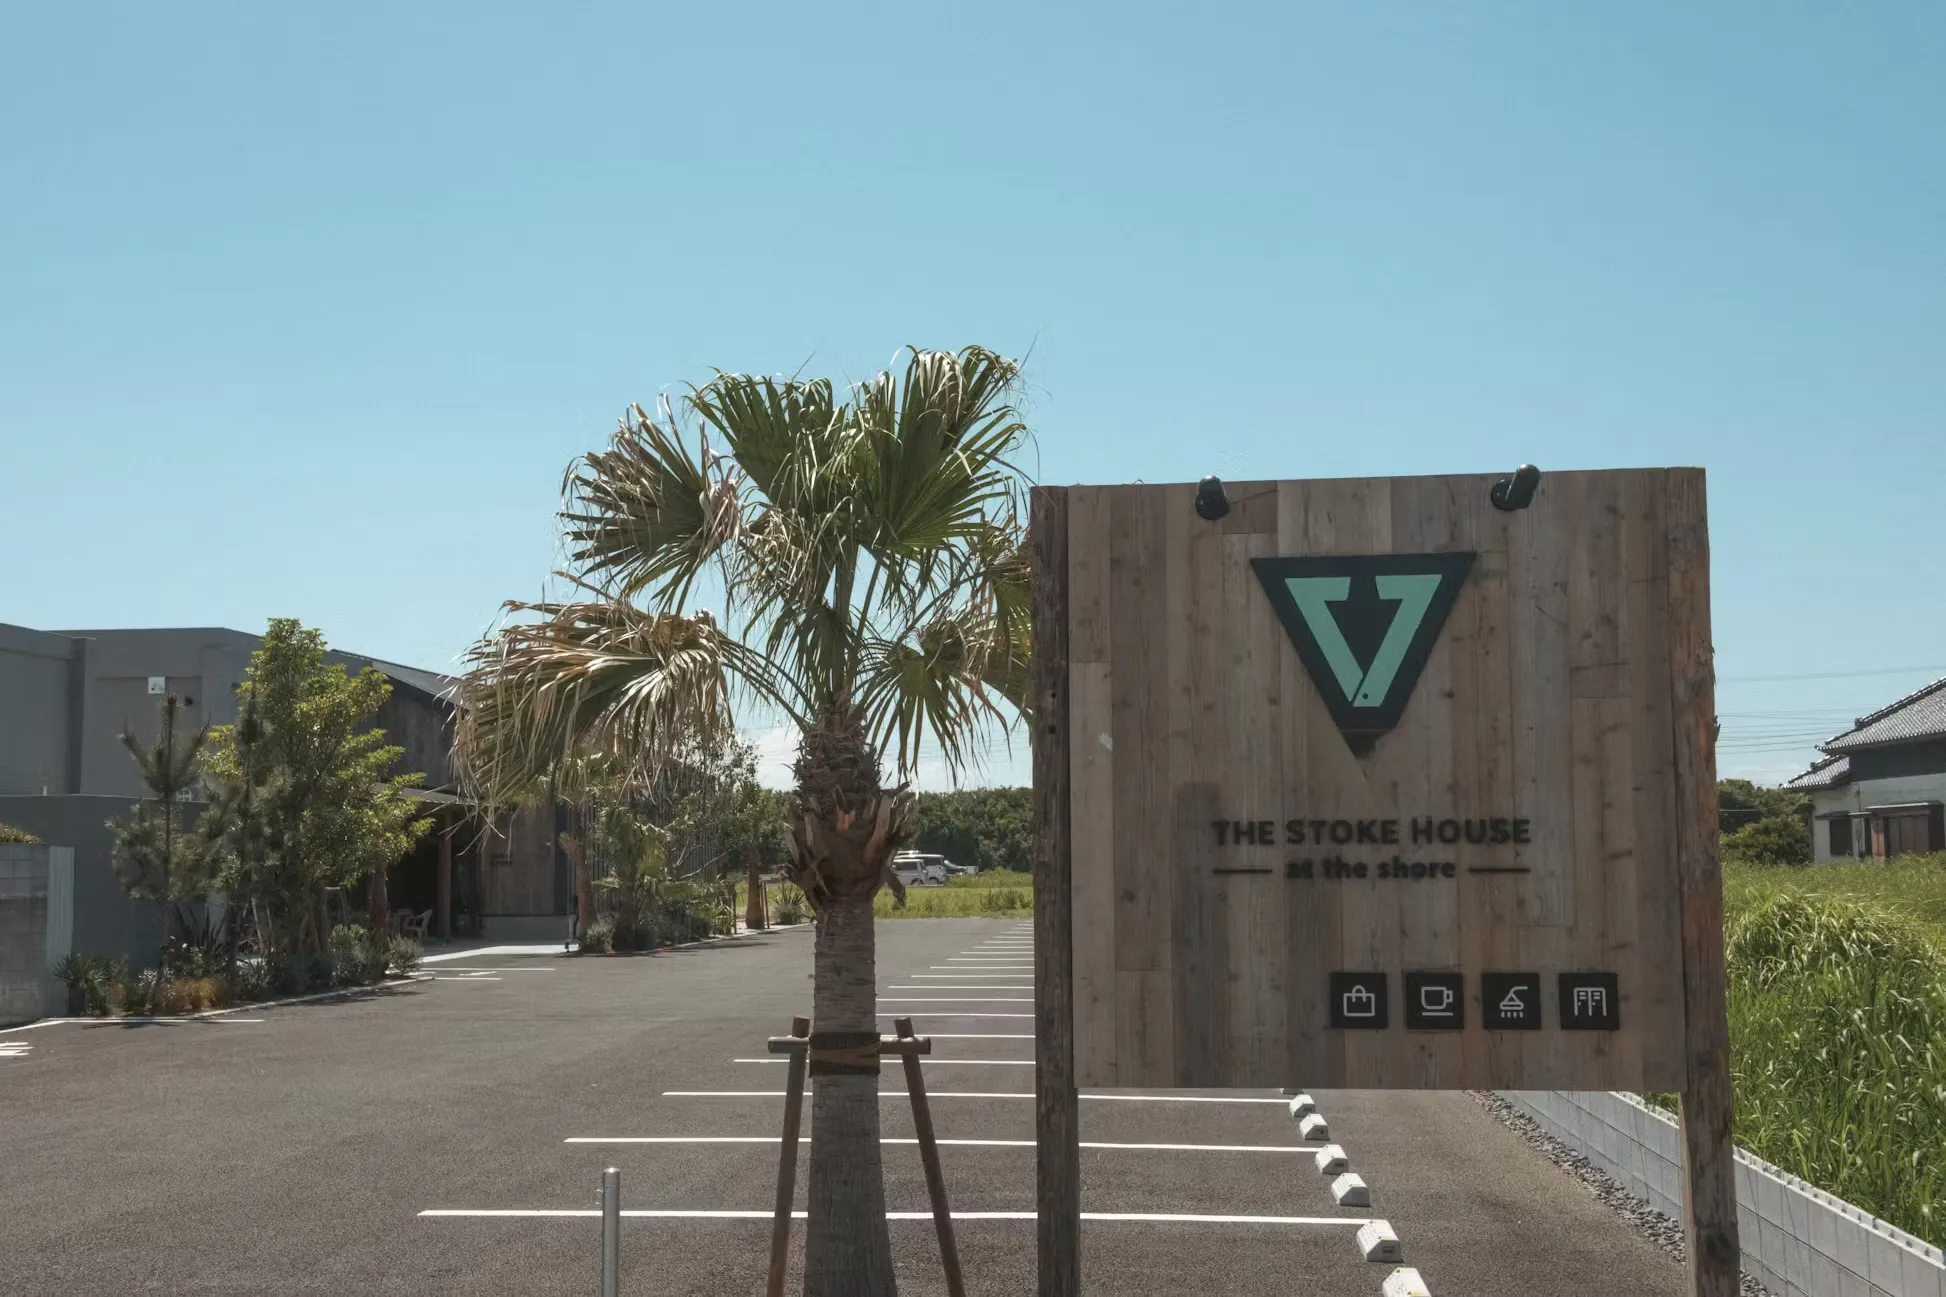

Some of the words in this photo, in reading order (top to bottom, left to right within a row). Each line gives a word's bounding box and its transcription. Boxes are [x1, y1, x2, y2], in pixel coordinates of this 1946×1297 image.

[1211, 819, 1275, 846] THE
[1286, 818, 1399, 845] STOKE
[1411, 816, 1531, 844] HOUSE
[1286, 858, 1314, 880] at
[1321, 855, 1369, 879] the
[1377, 855, 1457, 879] shore
